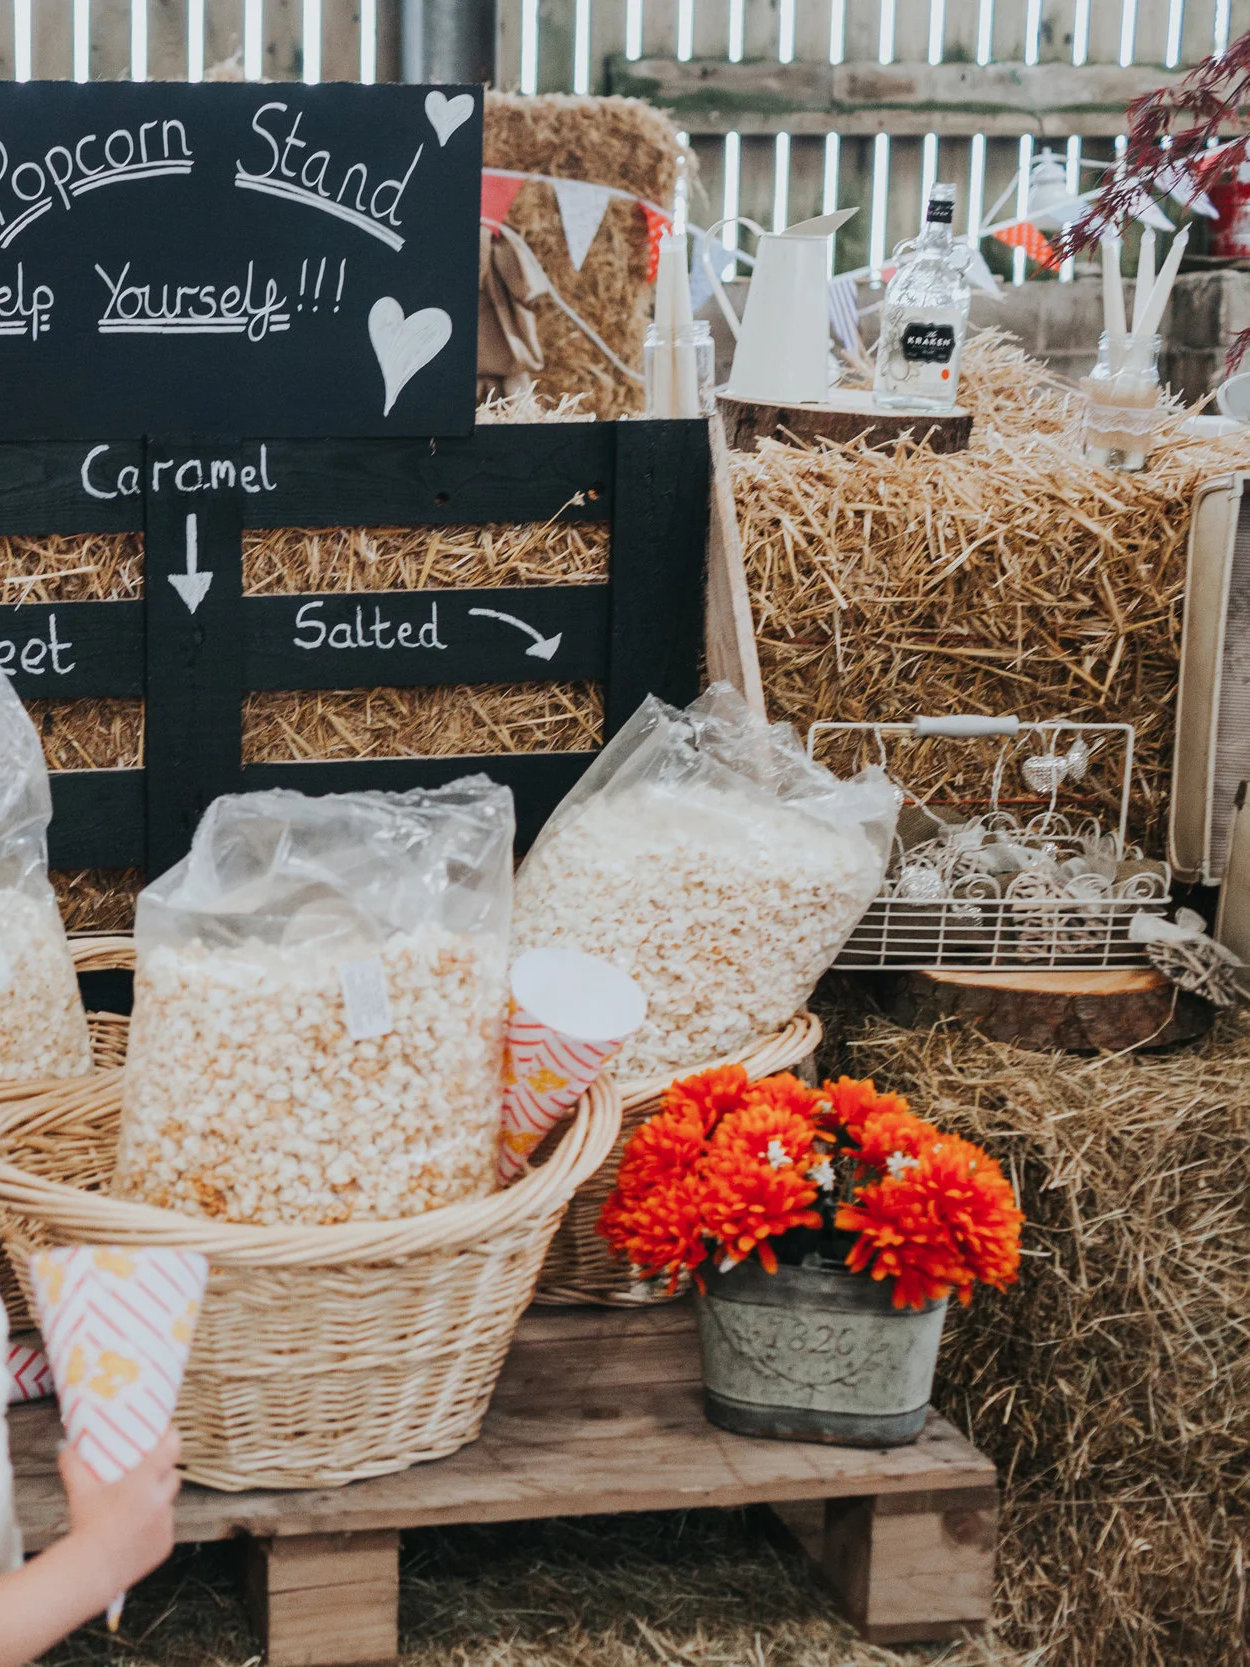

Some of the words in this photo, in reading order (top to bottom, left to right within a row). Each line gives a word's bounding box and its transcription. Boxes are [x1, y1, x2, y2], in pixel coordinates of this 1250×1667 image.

[235, 101, 424, 228] Stand
[95, 257, 348, 342] Yourself!!!
[906, 336, 951, 347] KRAKEN
[80, 444, 277, 499] Caramel
[294, 600, 448, 650] Salted
